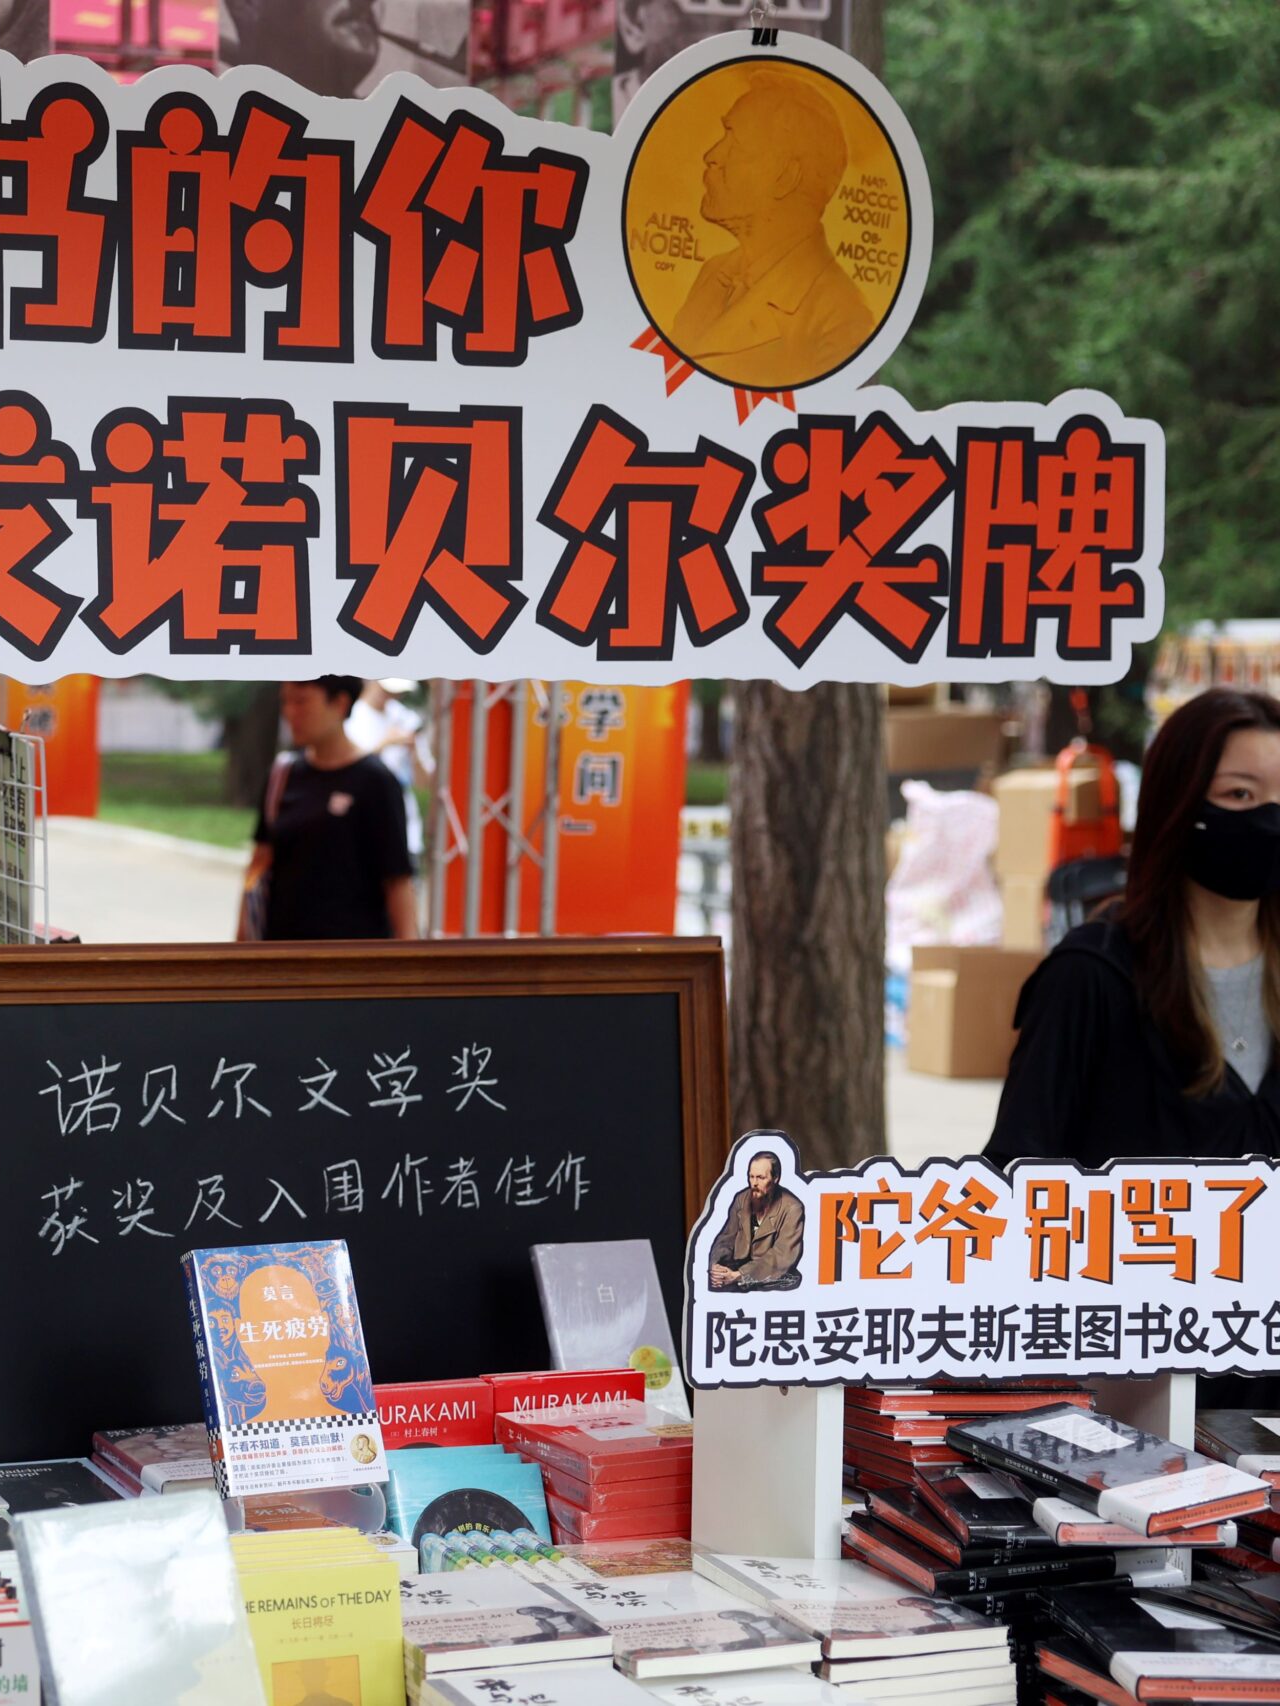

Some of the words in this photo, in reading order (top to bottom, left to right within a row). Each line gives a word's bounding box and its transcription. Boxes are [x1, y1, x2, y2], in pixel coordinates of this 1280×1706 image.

[838, 185, 899, 212] MDCCC
[629, 229, 706, 263] NOBEL
[835, 241, 899, 268] MDCCC
[851, 263, 892, 287] XCVI
[38, 1042, 507, 1135] 诺贝尔文学奖
[38, 1151, 592, 1256] 获奖及入围作者佳作
[263, 1285, 295, 1303] 莫言
[596, 1283, 616, 1303] 白
[239, 1316, 329, 1344] 生死疲劳
[379, 1400, 476, 1425] URAKAMI
[257, 1595, 318, 1613] REMAINS
[320, 1597, 336, 1609] OF
[337, 1592, 364, 1606] THE
[365, 1589, 392, 1604] DAY
[291, 1615, 335, 1630] 长日将尽
